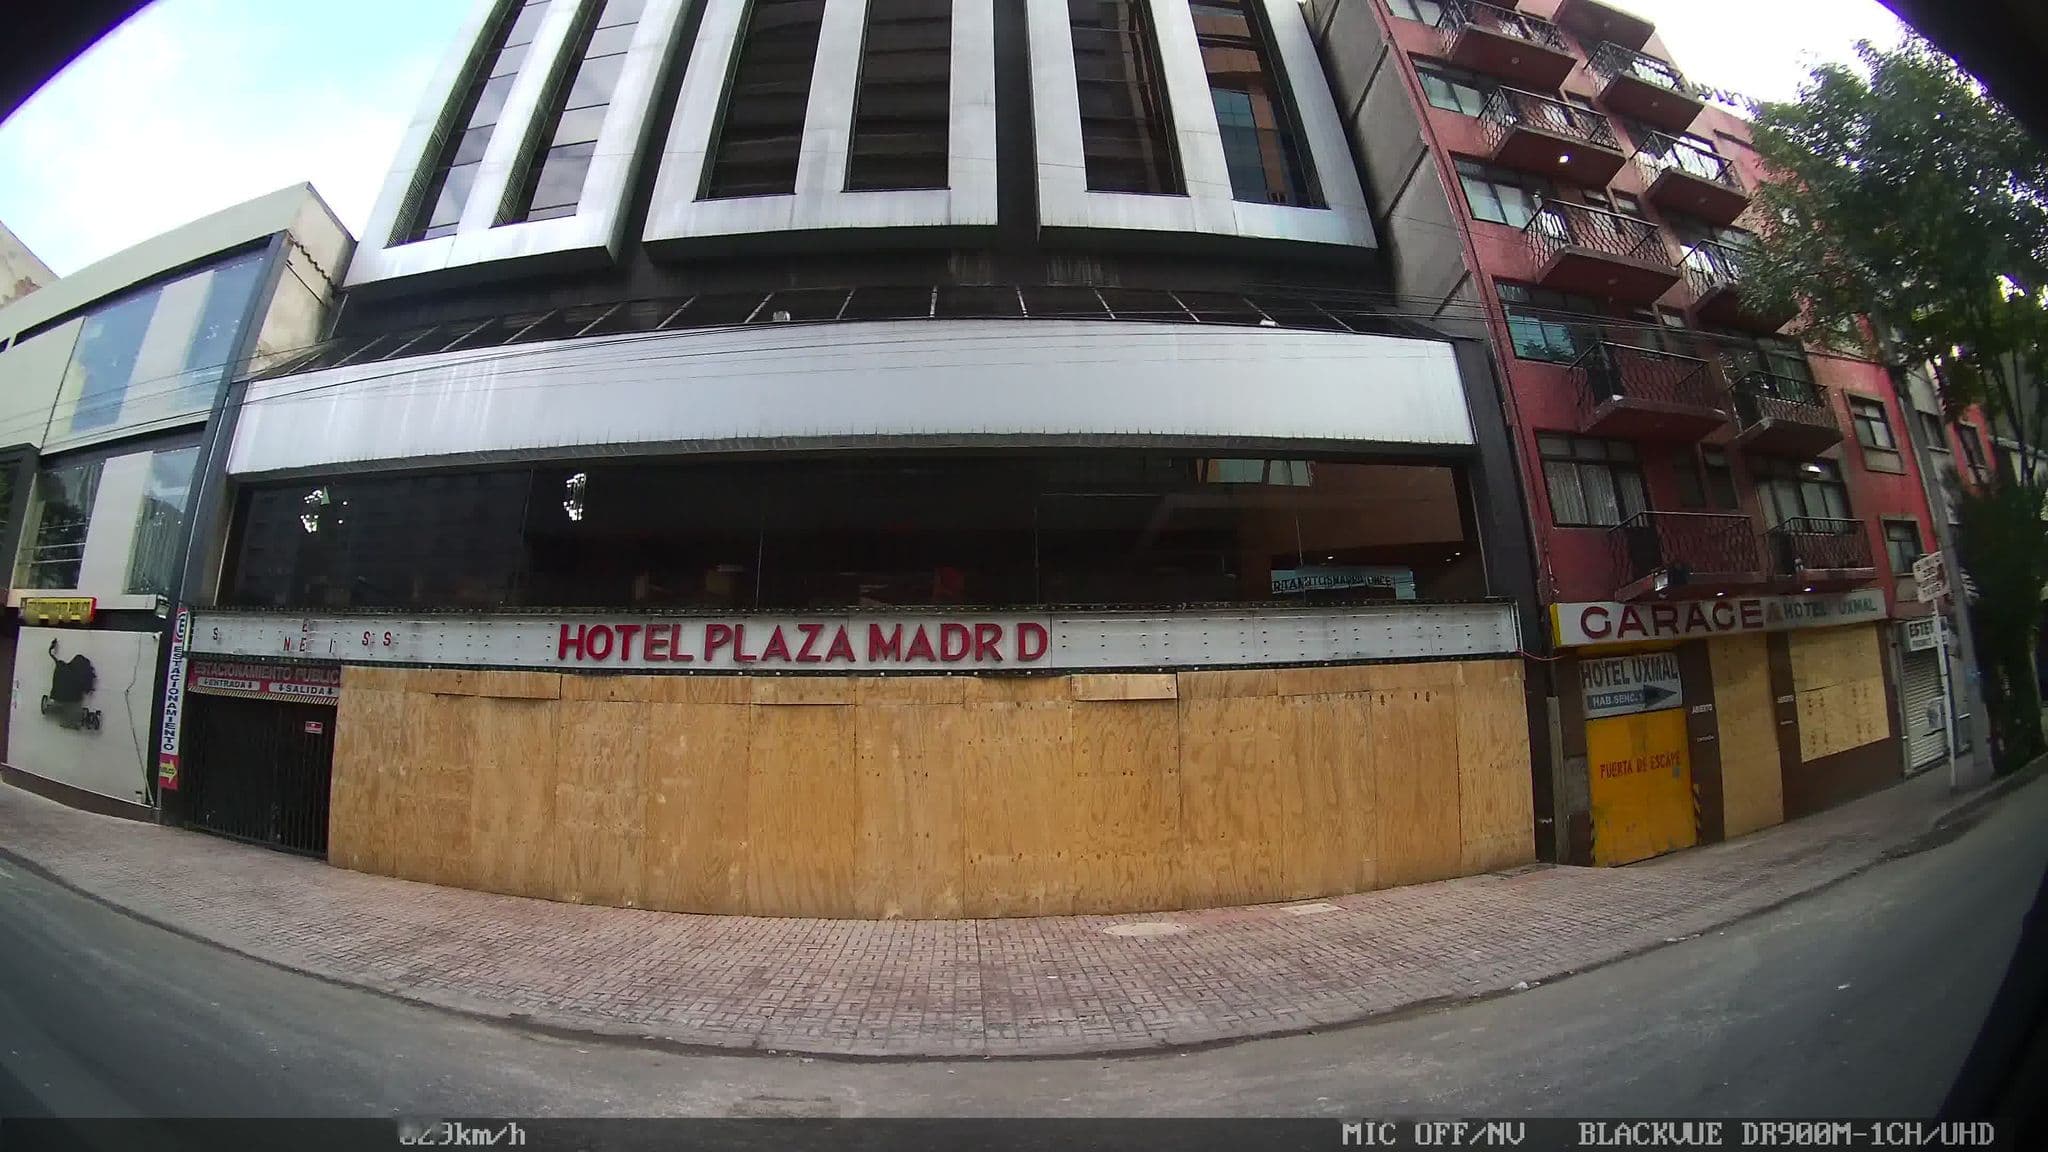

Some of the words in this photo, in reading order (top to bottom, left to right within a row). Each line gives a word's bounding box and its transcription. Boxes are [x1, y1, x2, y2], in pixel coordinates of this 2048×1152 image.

[1580, 600, 1764, 640] GARAGE
[1783, 602, 1828, 618] HOTEL
[557, 623, 695, 663] HOTEL
[703, 623, 857, 664] PLAZA
[194, 662, 292, 680] ESTACIONAMIENTO
[207, 679, 246, 689] ENTRADA
[1580, 660, 1630, 689] HOTEL
[1631, 656, 1679, 683] UXMAL
[163, 645, 184, 752] ESTACIONAMIENTO
[285, 685, 325, 695] SALIDA
[1600, 760, 1633, 779] PUERTA
[1636, 757, 1647, 774] DE
